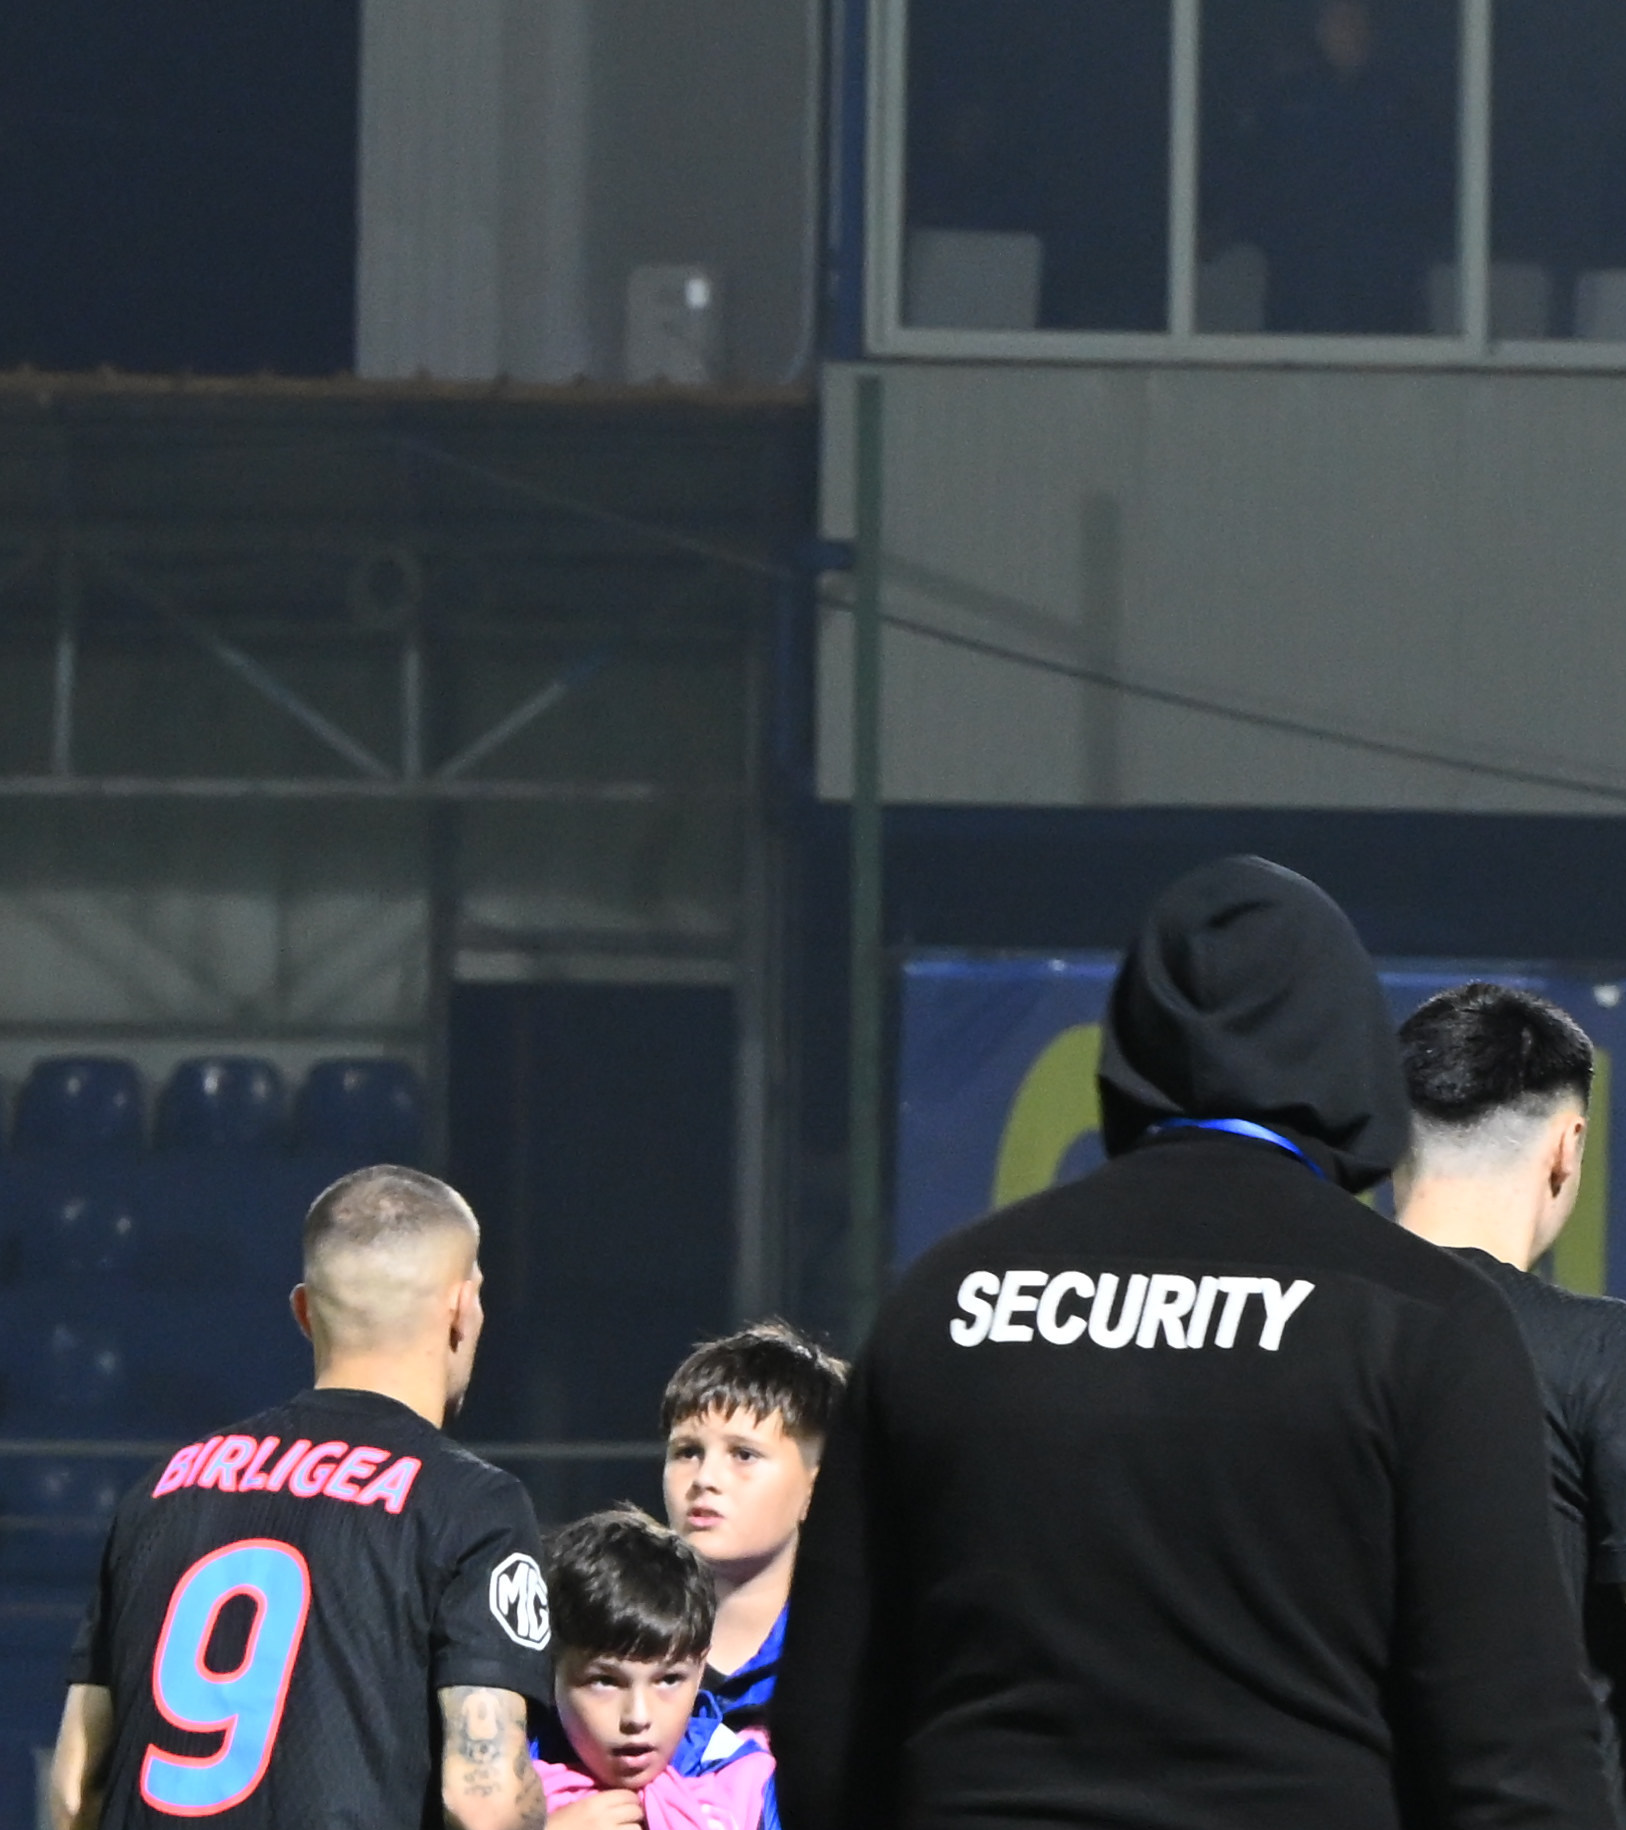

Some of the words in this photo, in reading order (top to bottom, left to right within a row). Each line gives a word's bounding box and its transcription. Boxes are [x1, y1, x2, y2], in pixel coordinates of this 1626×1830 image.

[949, 1270, 1314, 1351] SECURITY
[152, 1434, 422, 1514] BIRLIGEA
[497, 1561, 550, 1642] MG
[140, 1538, 311, 1817] 9
